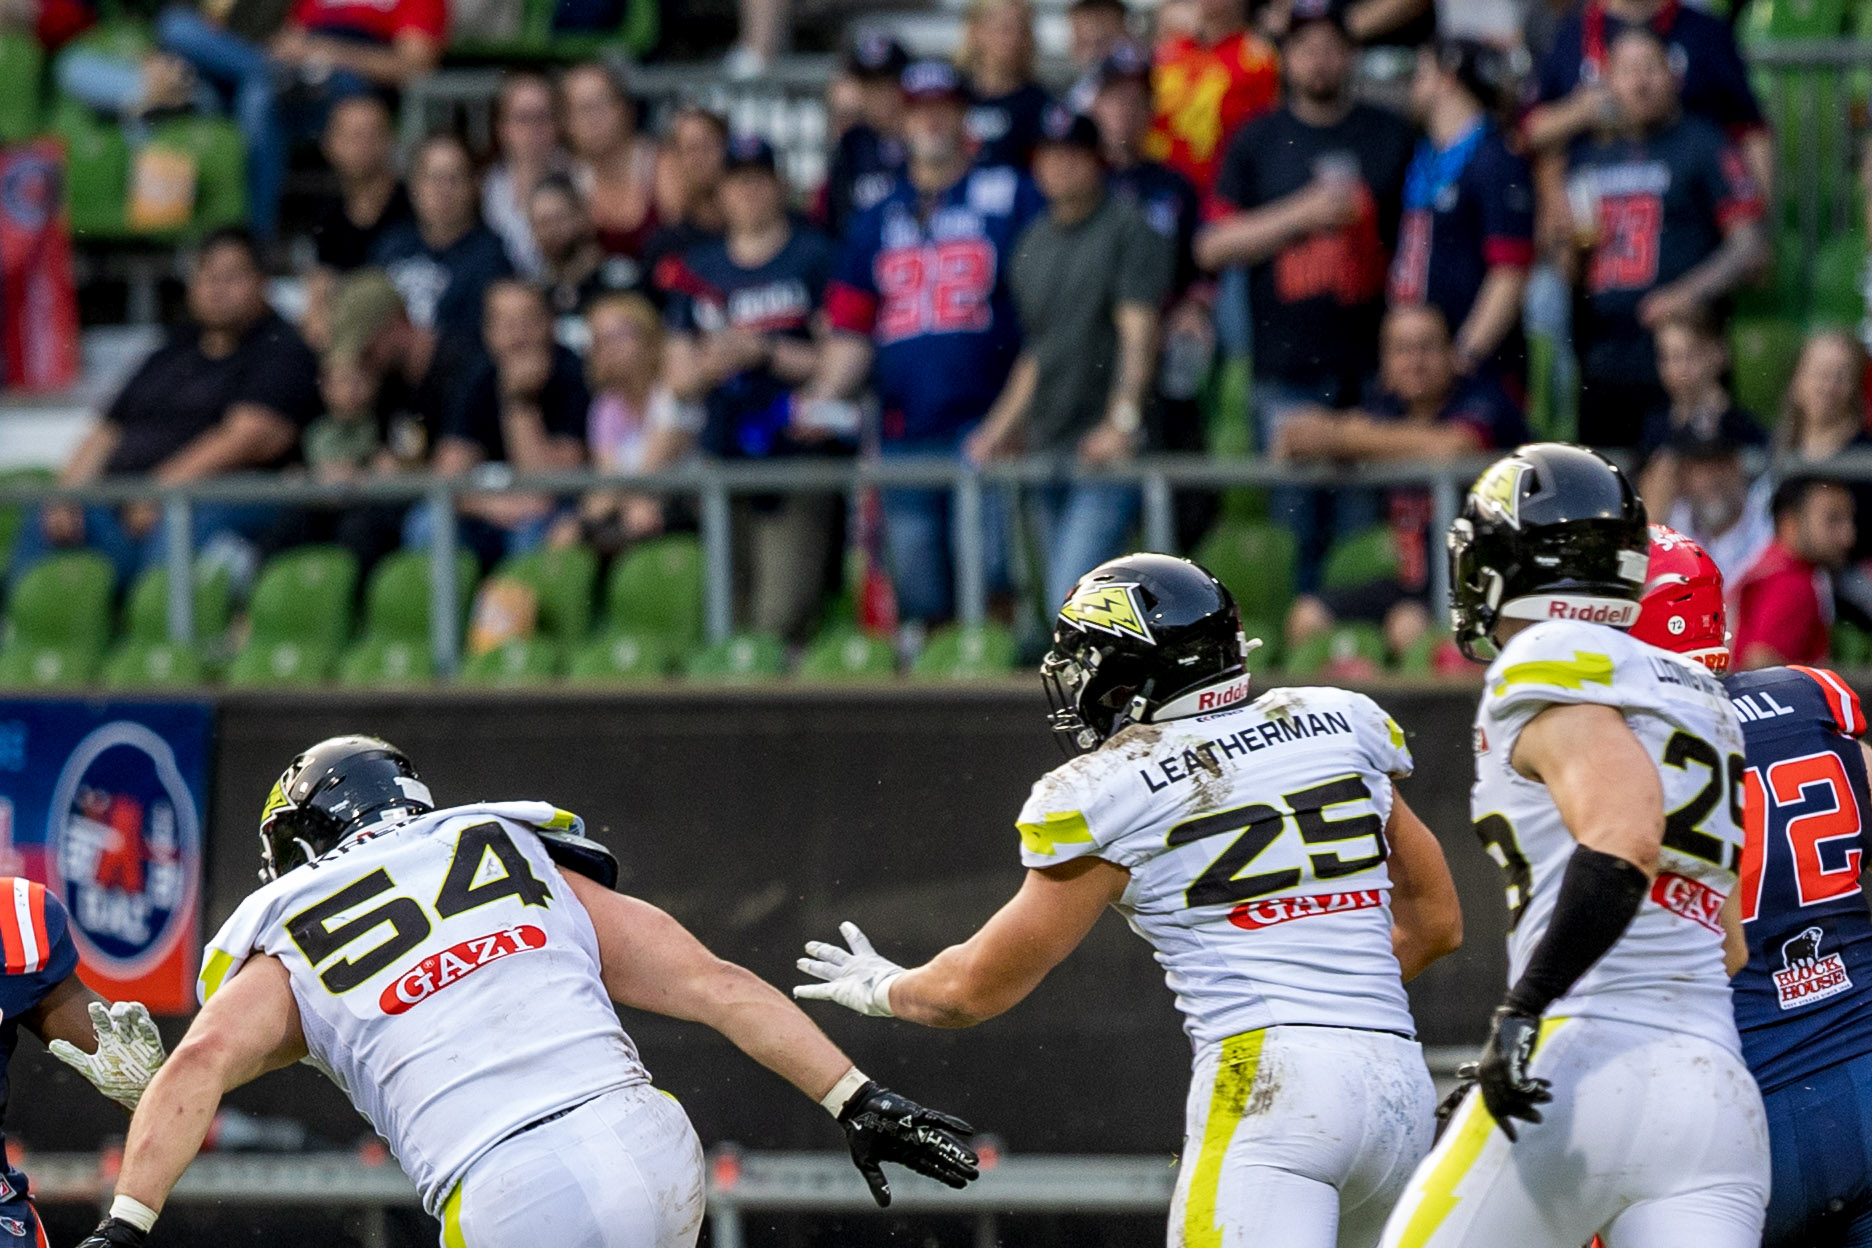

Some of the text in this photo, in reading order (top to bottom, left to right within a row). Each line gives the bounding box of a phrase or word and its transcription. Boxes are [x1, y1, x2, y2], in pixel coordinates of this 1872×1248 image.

[1548, 600, 1633, 624] Riddell
[1198, 679, 1250, 711] Ridde
[1139, 710, 1353, 794] LEATHERMAN
[1165, 773, 1389, 908] 25
[283, 820, 555, 996] 54
[1663, 877, 1726, 932] GAZ
[395, 927, 534, 1003] GAZI
[1775, 954, 1843, 987] BLOCK
[1780, 968, 1848, 1002] HOUSE
